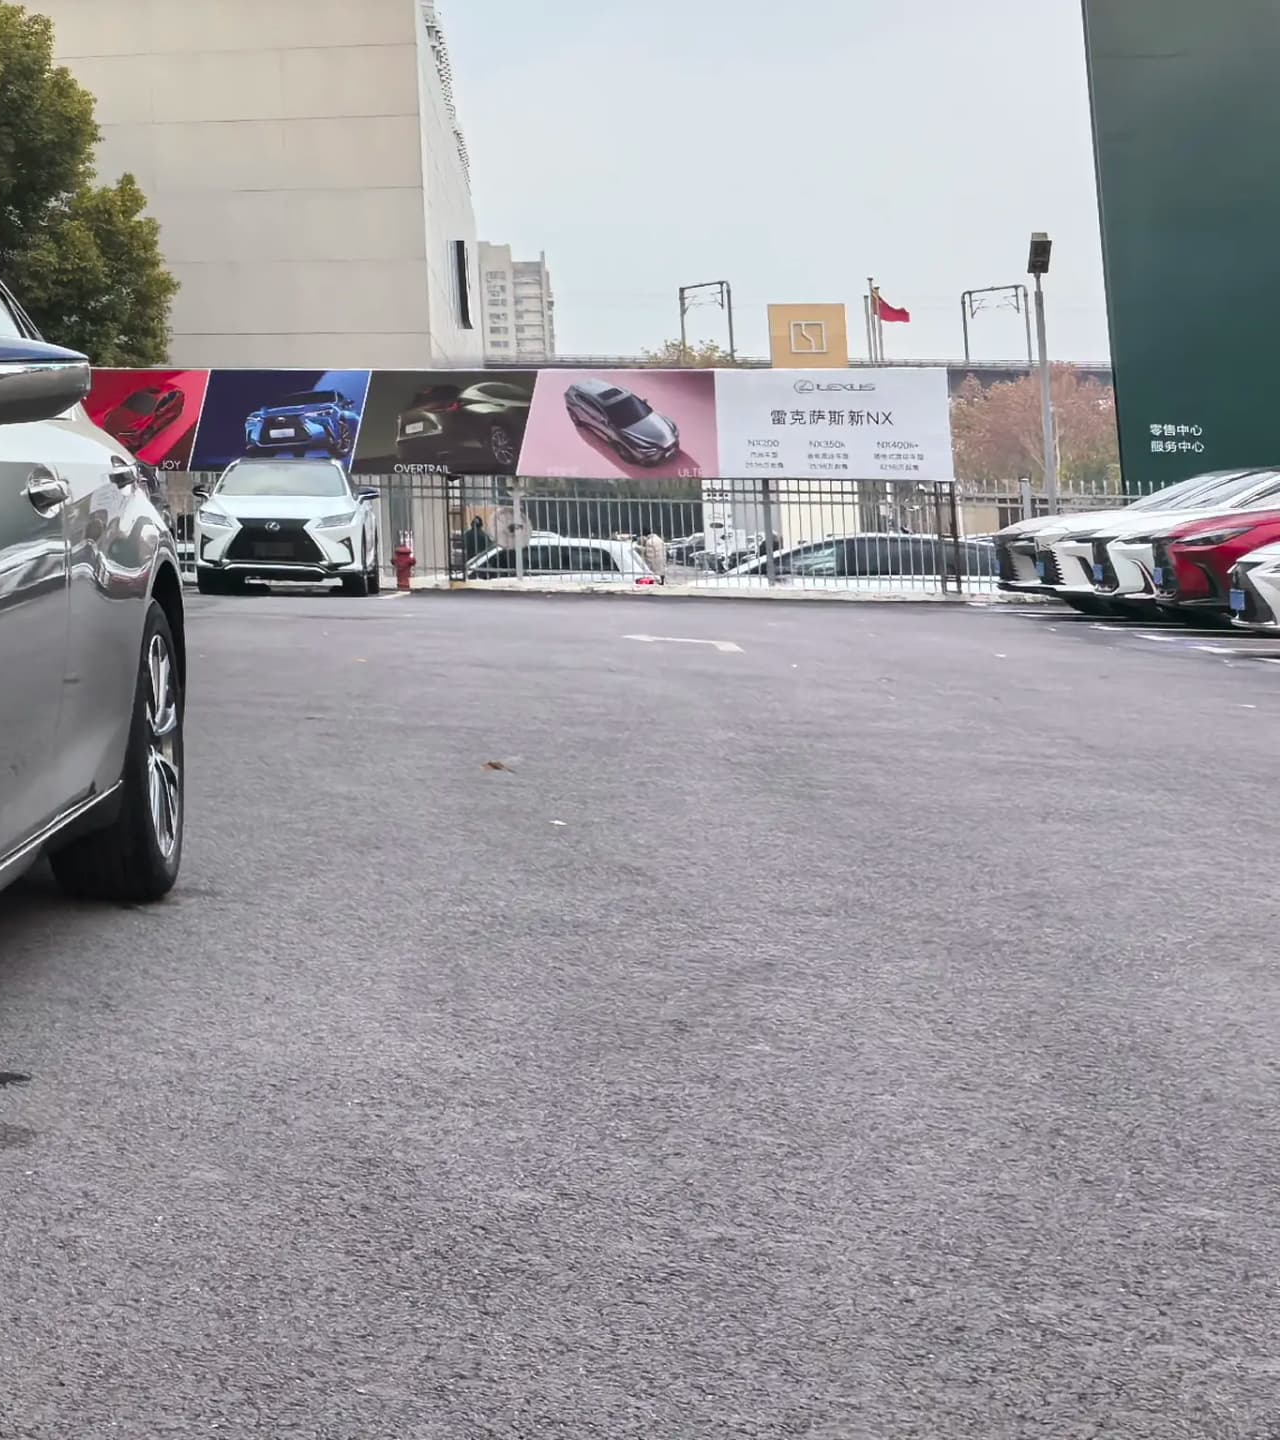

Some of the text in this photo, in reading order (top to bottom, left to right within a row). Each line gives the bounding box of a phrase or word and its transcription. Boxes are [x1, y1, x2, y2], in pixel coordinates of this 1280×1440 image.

[816, 383, 876, 392] LEXUS
[770, 410, 895, 427] 雷克萨斯新NX
[1149, 423, 1203, 437] 零售中心
[1151, 440, 1205, 453] 服务中心
[394, 463, 451, 474] OVERTRAIL
